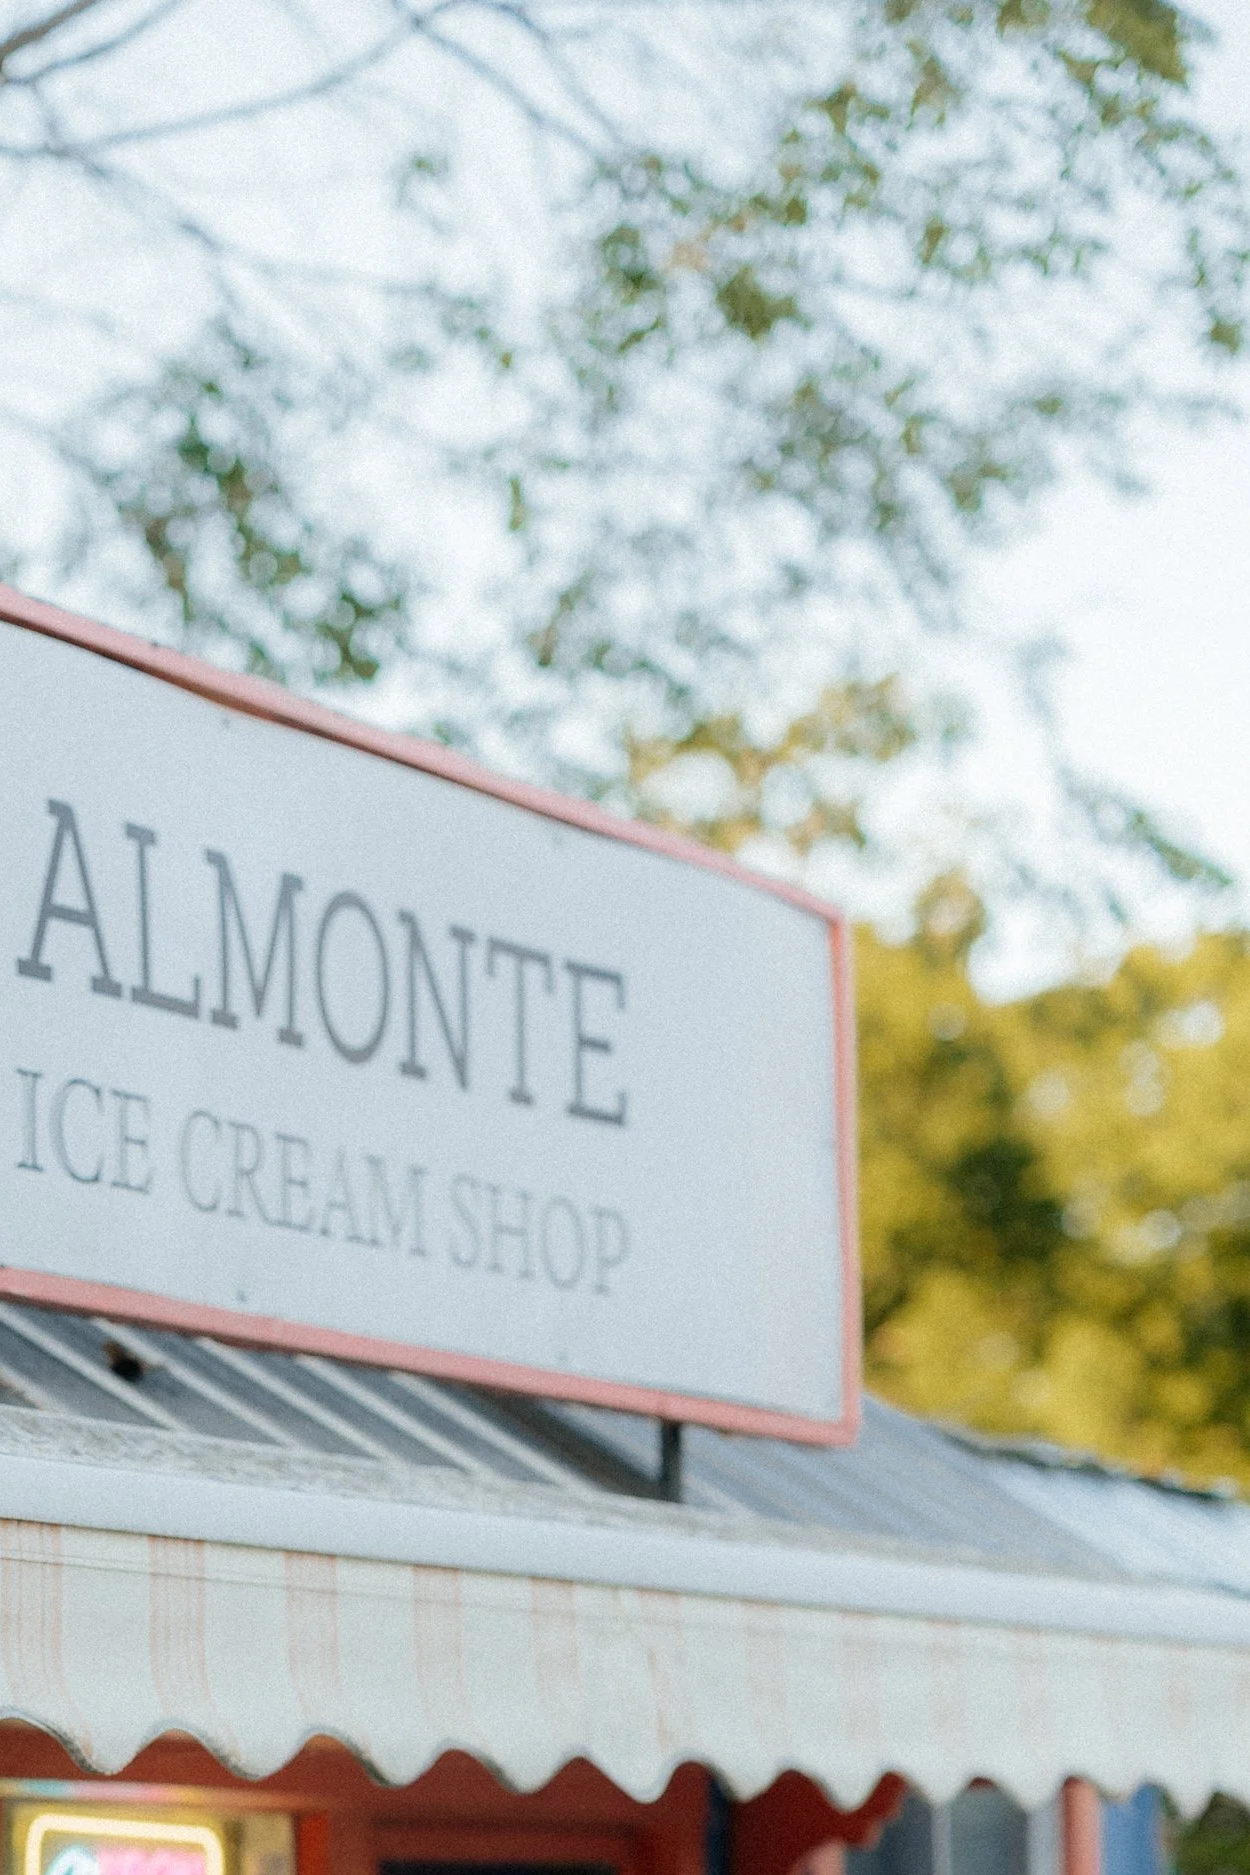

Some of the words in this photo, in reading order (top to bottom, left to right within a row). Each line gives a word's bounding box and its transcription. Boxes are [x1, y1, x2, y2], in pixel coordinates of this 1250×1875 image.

[16, 799, 628, 1128] ALMONTE
[15, 1067, 151, 1196] ICE
[179, 1110, 428, 1259] CREAM
[446, 1173, 632, 1298] SHOP
